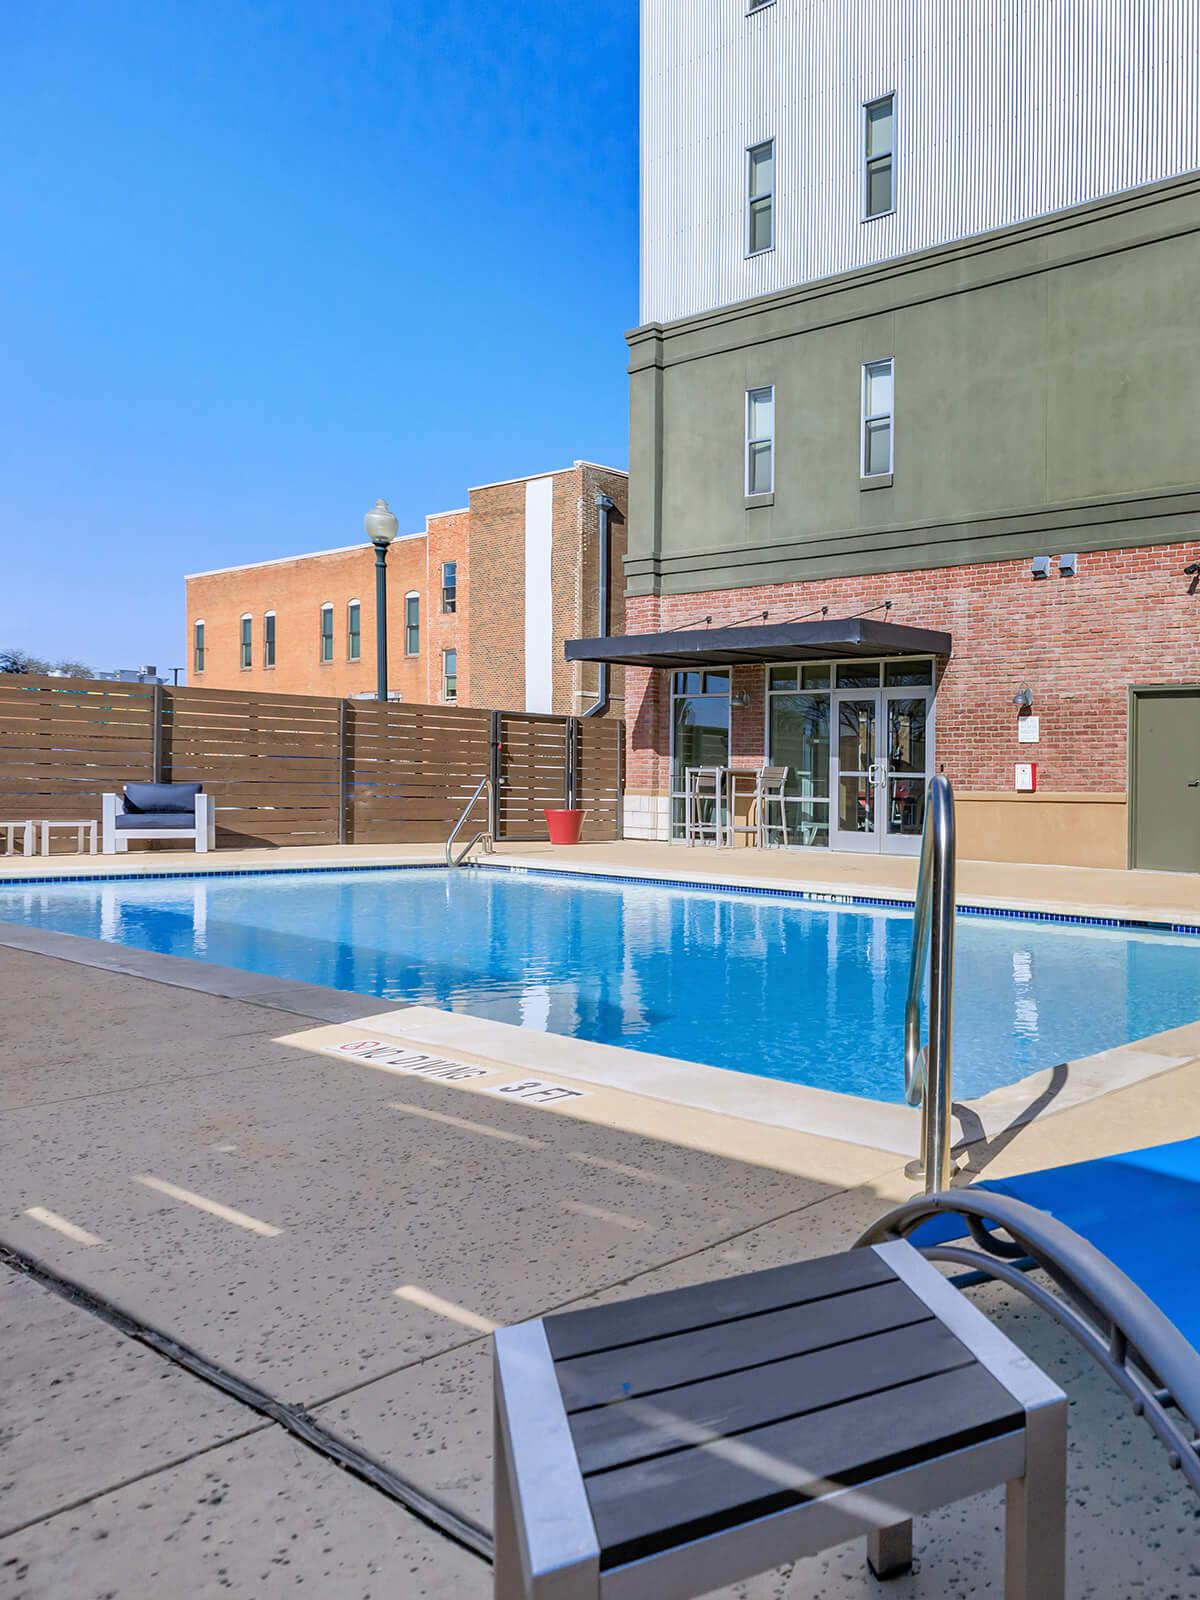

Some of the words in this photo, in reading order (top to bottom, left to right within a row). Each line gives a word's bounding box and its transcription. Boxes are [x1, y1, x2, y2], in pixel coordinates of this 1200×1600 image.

[352, 1046, 404, 1059] NO
[388, 1055, 487, 1080] DIVING
[500, 1082, 542, 1093] 3
[521, 1087, 583, 1103] FT
